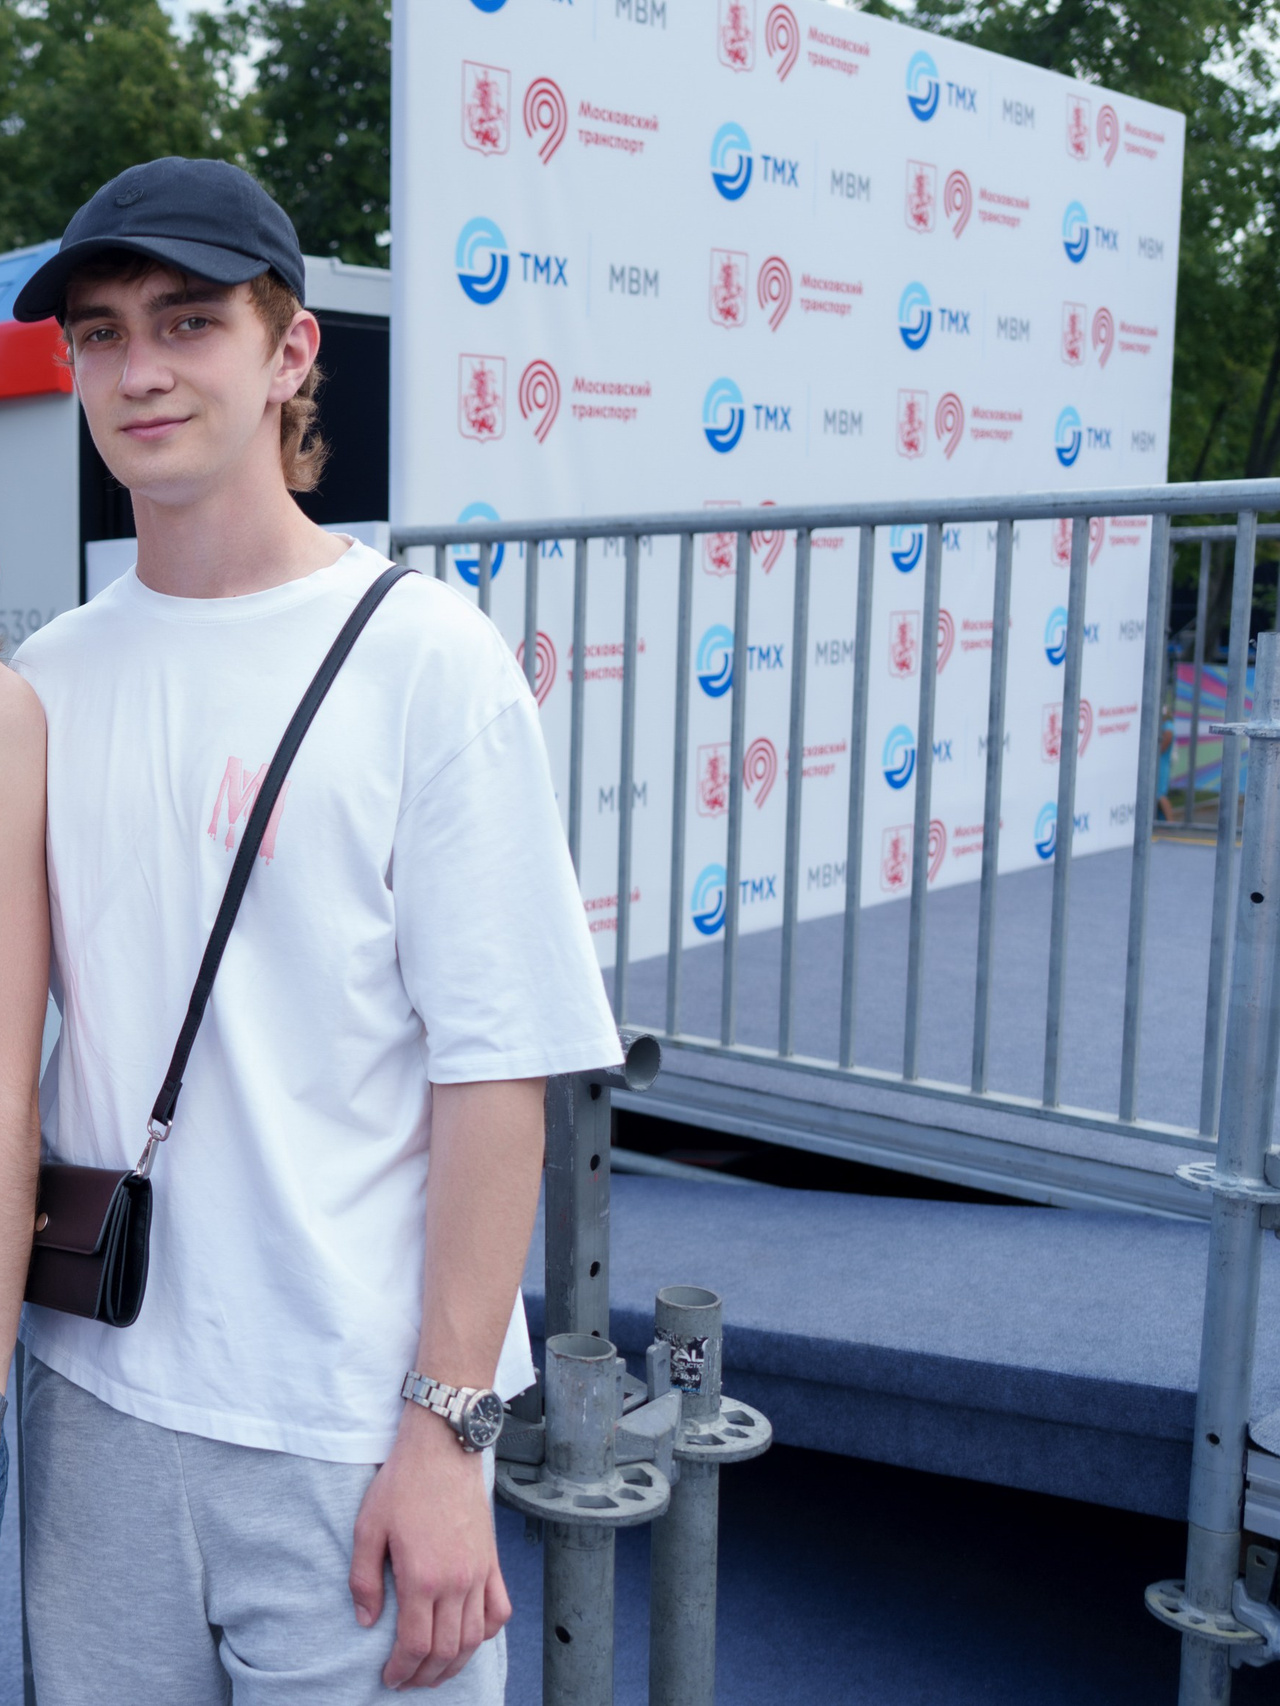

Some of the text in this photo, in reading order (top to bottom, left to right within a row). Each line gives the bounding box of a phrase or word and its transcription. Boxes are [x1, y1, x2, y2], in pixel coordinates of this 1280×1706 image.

[807, 26, 871, 57] Московский
[807, 51, 860, 77] транспорт
[578, 100, 659, 132] Московский
[946, 82, 1035, 129] ТМХ МВМ
[578, 129, 646, 156] транспорт
[761, 155, 871, 202] ТМХ МВМ
[978, 187, 1031, 211] Московский
[978, 208, 1021, 229] транспорт
[1094, 226, 1164, 261] ТМХ МВМ
[519, 252, 659, 298] ТМХ МВМ
[800, 272, 864, 296] Московский
[800, 297, 852, 318] транспорт
[938, 307, 1031, 342] ТМХ МВМ
[572, 376, 652, 398] Московский
[572, 403, 639, 424] транспорт
[753, 404, 863, 436] ТМХ МВМ
[970, 405, 1023, 423] Московский
[970, 425, 1013, 443] транспорт
[1086, 427, 1156, 453] ТМХ МВМ
[603, 536, 653, 557] ММ
[1082, 622, 1100, 644] МХ
[747, 638, 855, 671] ТМХ МВМ
[932, 739, 954, 763] МХ
[598, 781, 647, 814] ММ
[1072, 812, 1090, 832] МХ
[739, 861, 847, 905] ТМХ МВМ
